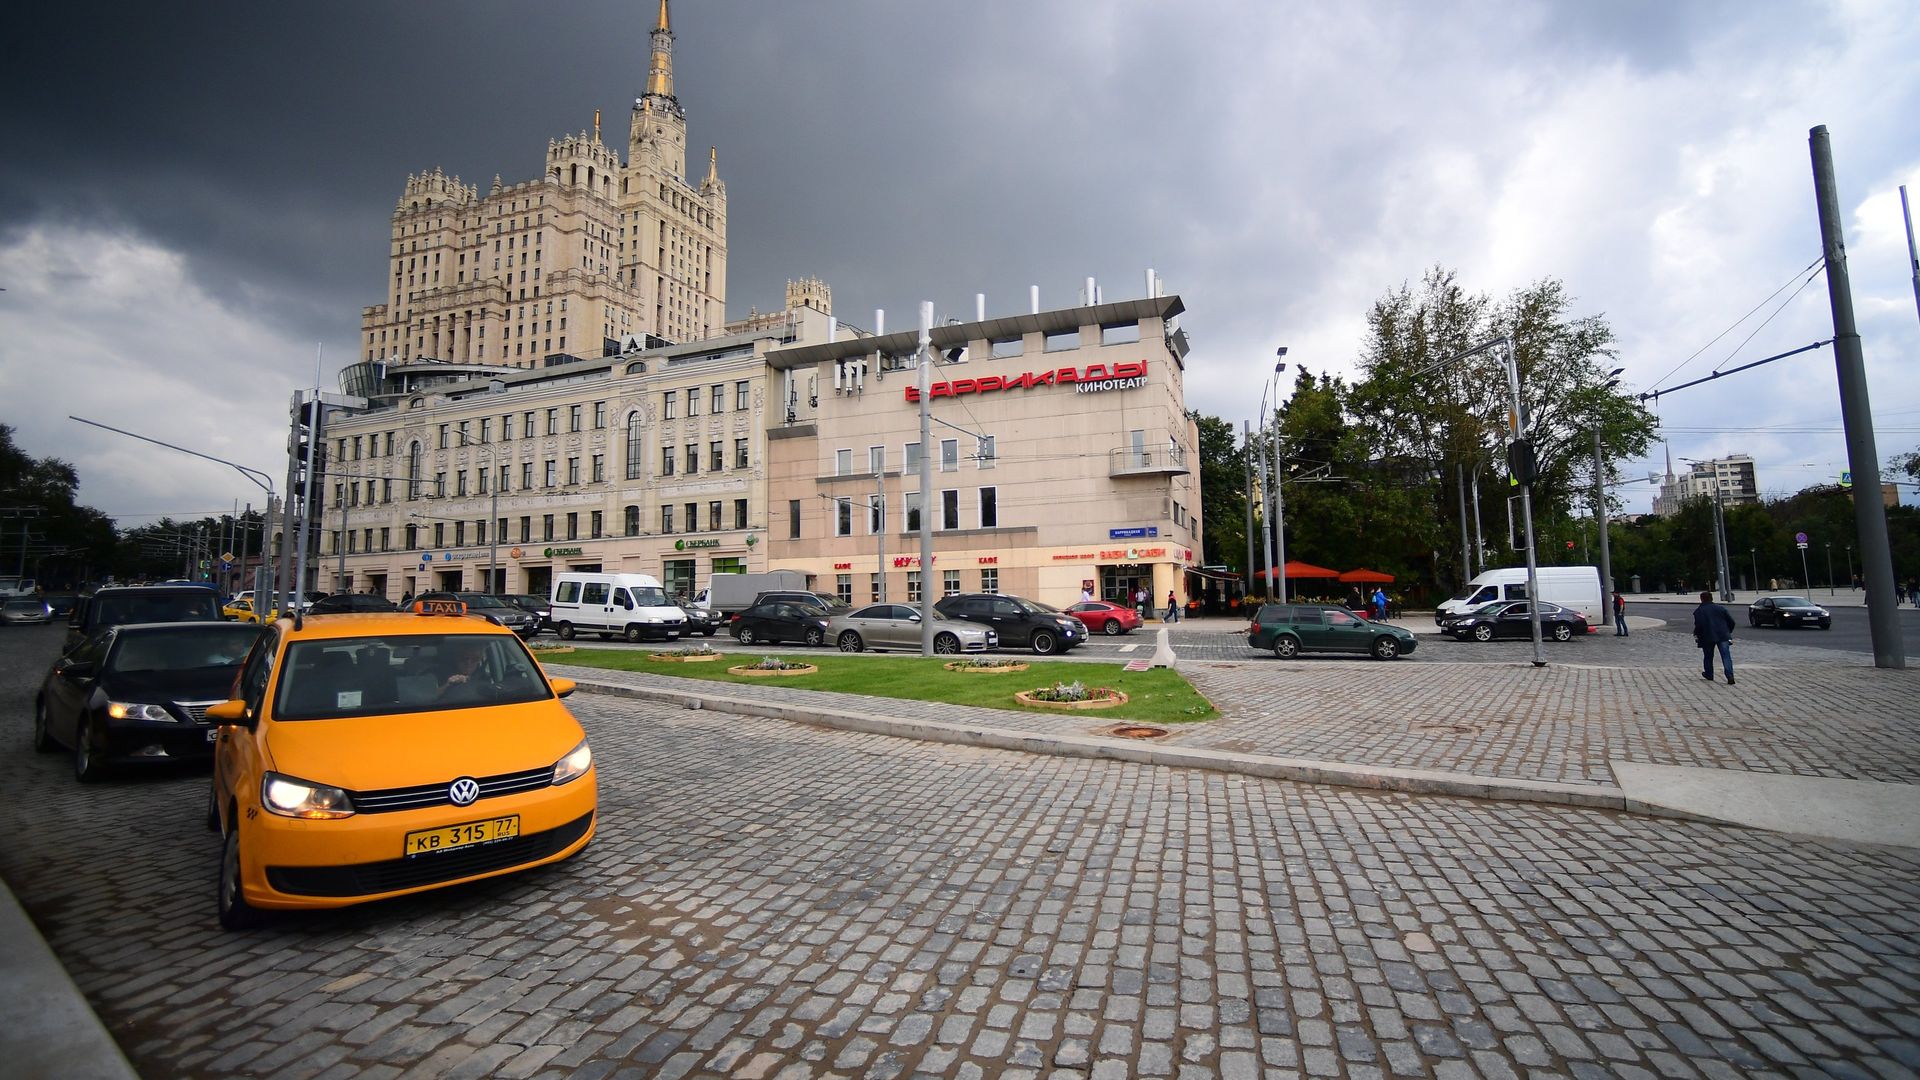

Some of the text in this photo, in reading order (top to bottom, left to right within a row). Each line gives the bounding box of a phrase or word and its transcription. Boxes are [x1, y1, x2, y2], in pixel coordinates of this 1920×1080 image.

[1075, 376, 1149, 394] КИНОТЕАТР
[685, 538, 720, 549] СБЕРБАНК
[553, 547, 583, 557] СБЕРБАНК
[834, 562, 852, 570] КАФЕ
[978, 556, 998, 565] КАФЕ
[428, 602, 458, 613] TAXI
[449, 824, 485, 844] 315
[495, 818, 513, 832] 77
